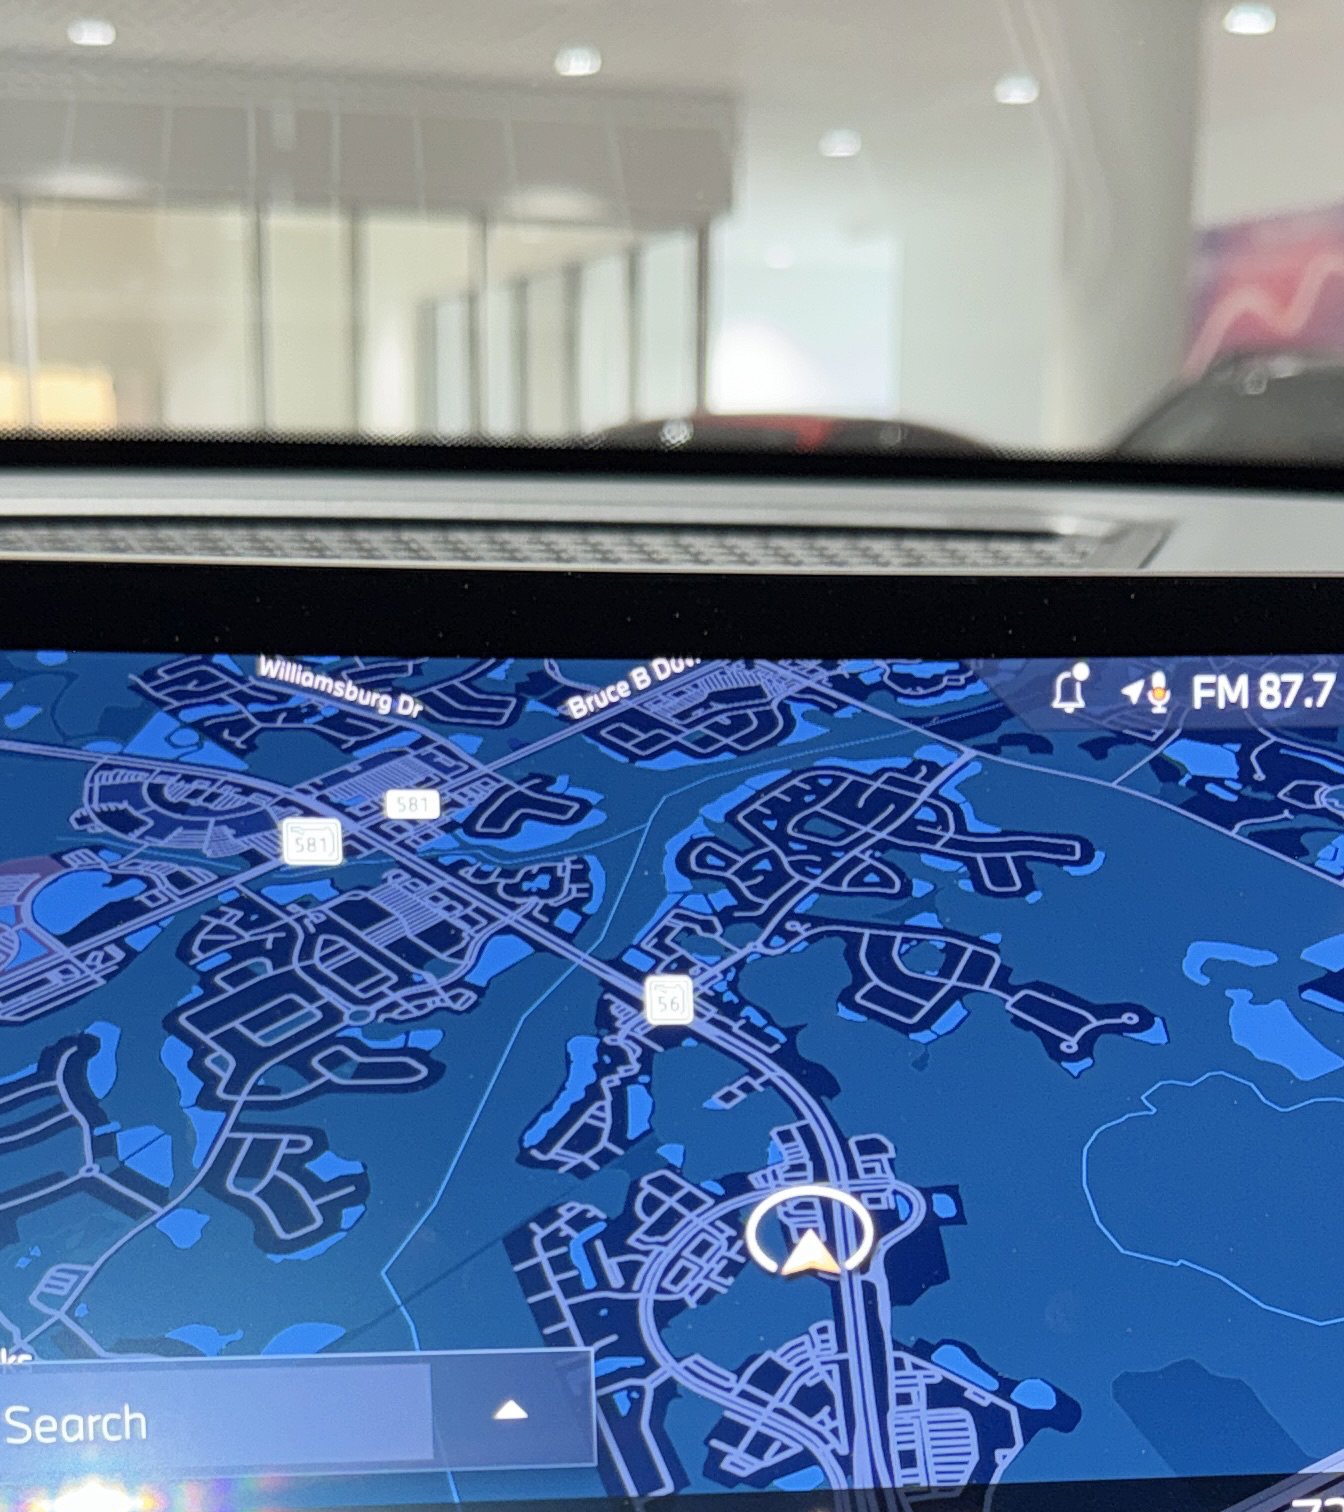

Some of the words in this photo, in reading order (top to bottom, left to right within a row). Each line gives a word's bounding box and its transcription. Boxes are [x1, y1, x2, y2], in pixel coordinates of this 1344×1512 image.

[259, 653, 394, 715] Williamsburg
[397, 692, 424, 718] Dr
[567, 680, 632, 720] Bruce
[629, 665, 653, 691] B
[1192, 673, 1249, 710] FM
[1258, 671, 1337, 709] 87.7
[396, 796, 429, 813] 581
[294, 837, 327, 854] 581
[658, 995, 680, 1013] 56
[4, 1402, 148, 1445] Search
